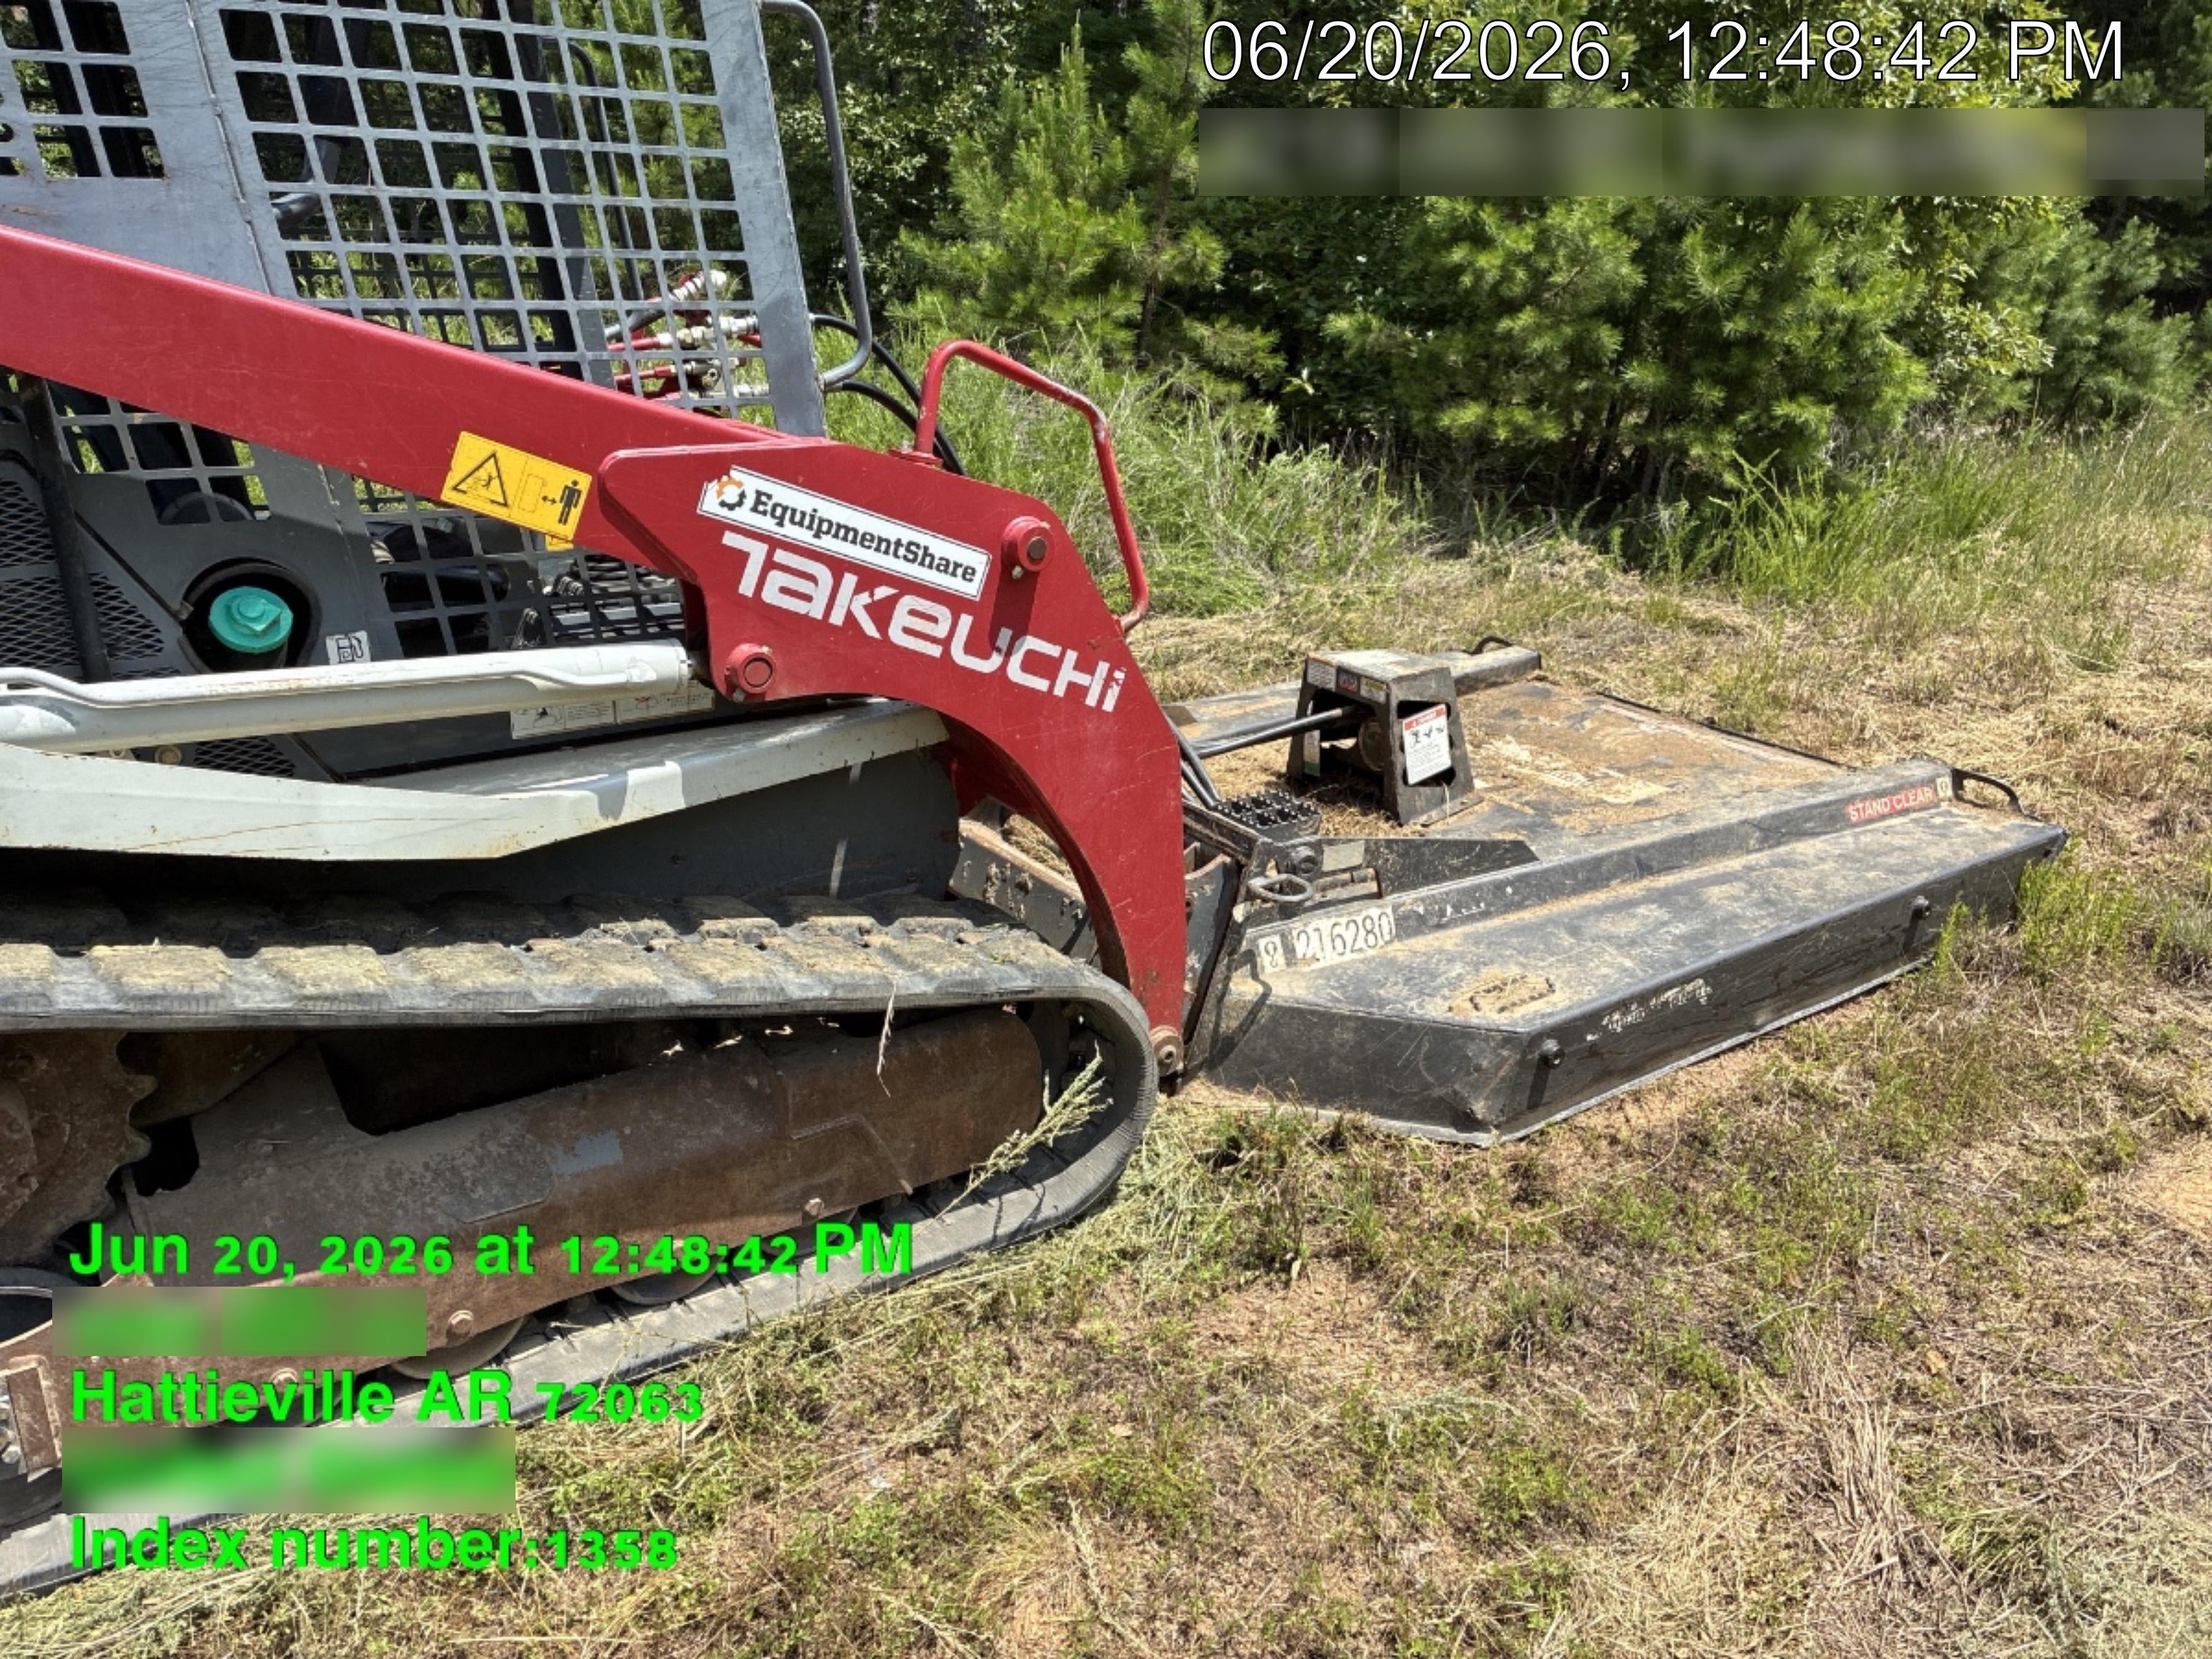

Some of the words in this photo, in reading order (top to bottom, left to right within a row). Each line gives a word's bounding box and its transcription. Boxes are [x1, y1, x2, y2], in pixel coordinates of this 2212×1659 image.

[750, 489, 977, 584] EquipmentShare
[1849, 798, 1891, 822] STAND
[1892, 785, 1934, 810] CLEAR
[1297, 911, 1393, 962] 216280
